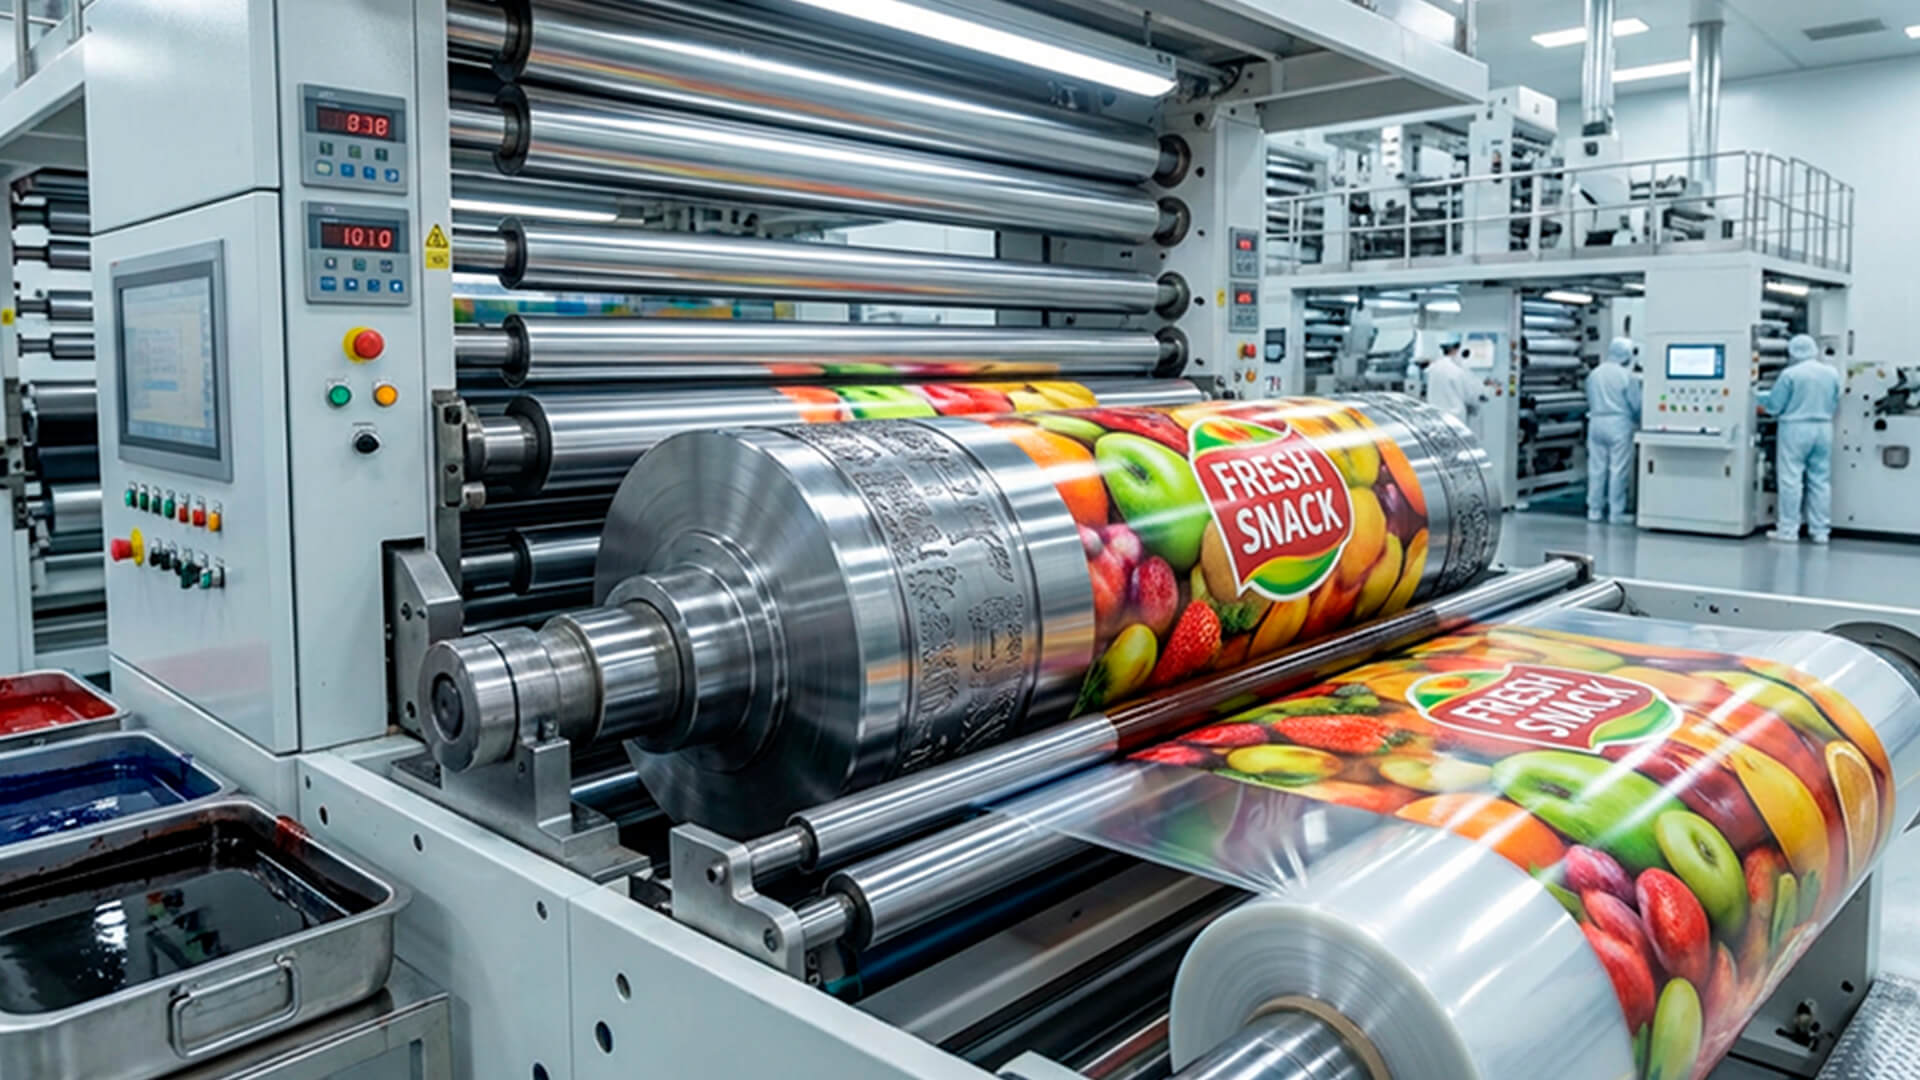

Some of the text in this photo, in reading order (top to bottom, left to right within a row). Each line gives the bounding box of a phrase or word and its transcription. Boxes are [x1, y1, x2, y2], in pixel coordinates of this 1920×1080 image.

[1210, 449, 1323, 502] FRESH
[1236, 487, 1344, 555] SNACK
[1449, 672, 1575, 725] FRESH
[1513, 679, 1638, 738] SNACK
